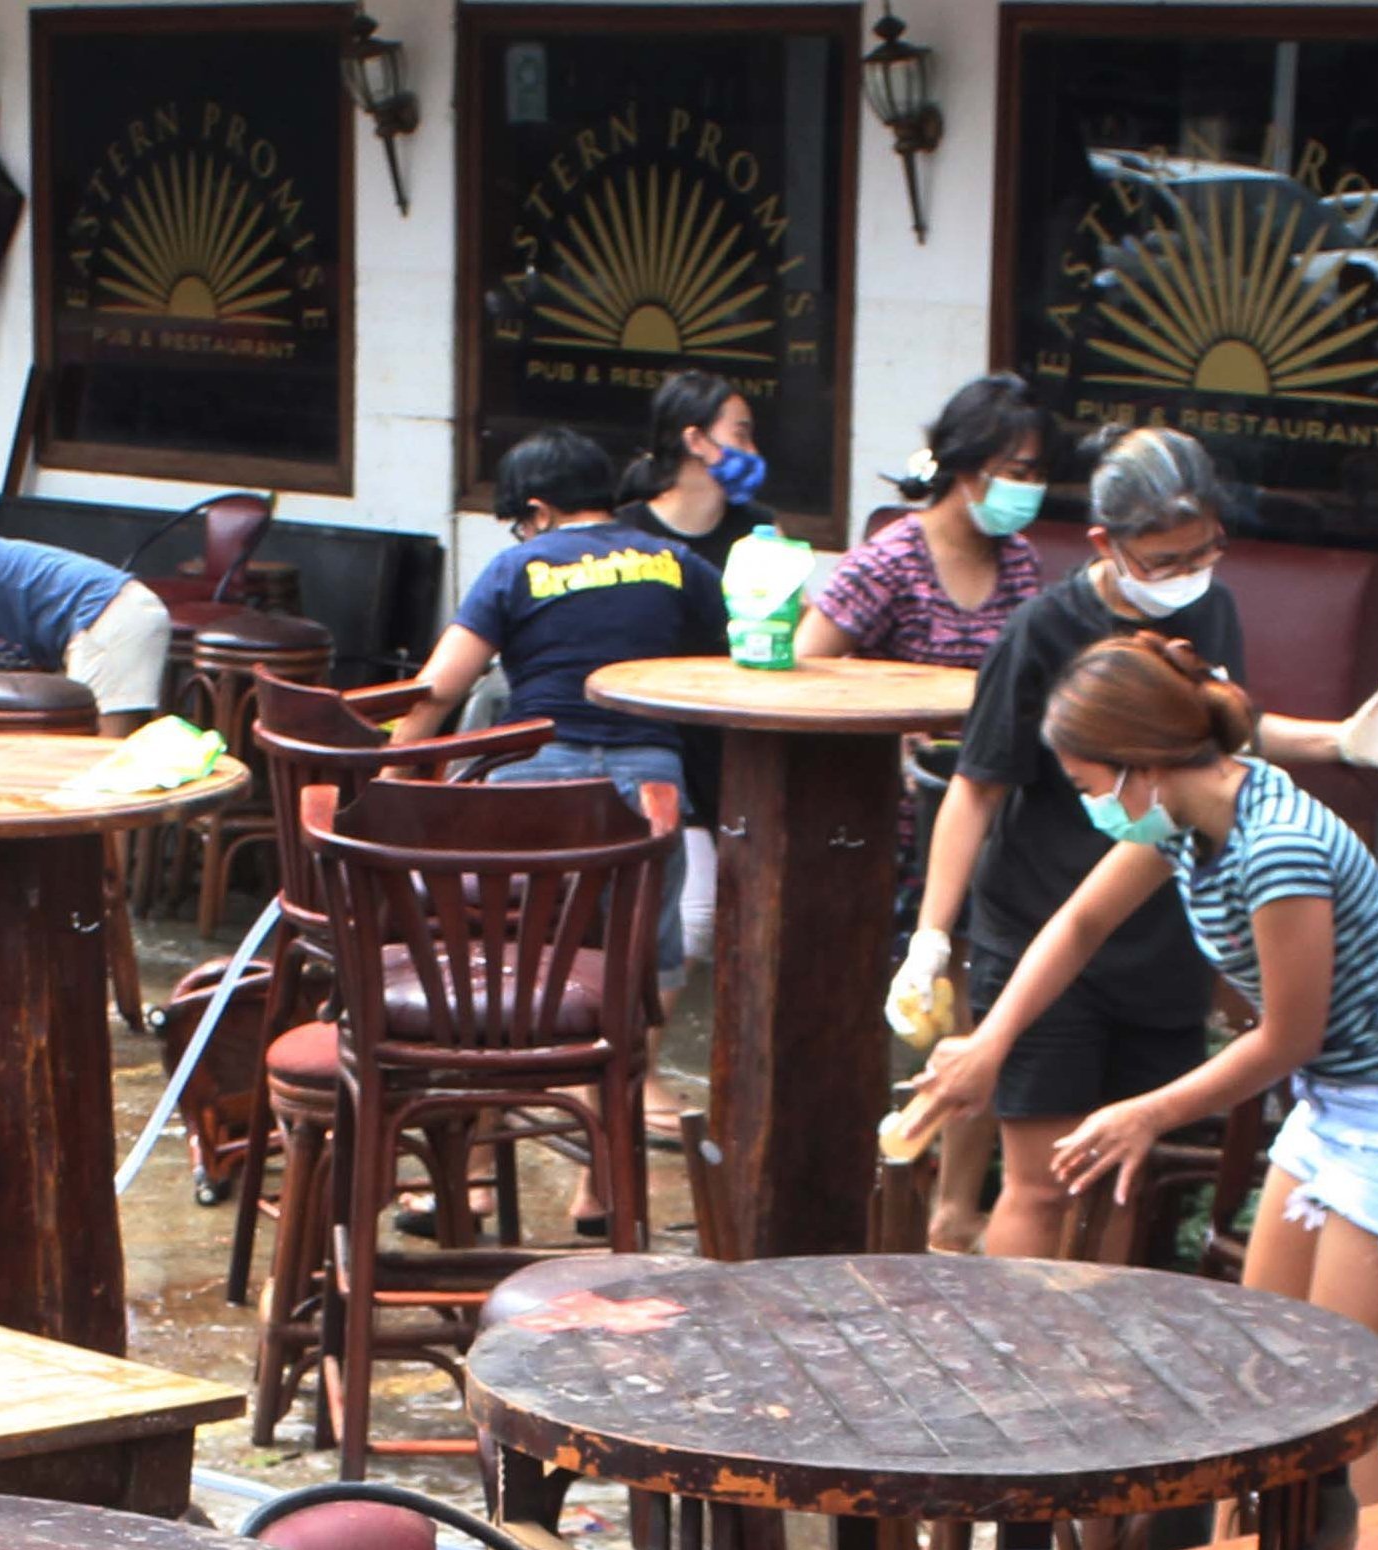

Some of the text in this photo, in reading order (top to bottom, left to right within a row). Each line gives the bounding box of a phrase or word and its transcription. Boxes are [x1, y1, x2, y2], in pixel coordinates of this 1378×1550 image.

[66, 100, 328, 330] EASTERN PROMISE
[495, 101, 818, 365] EASTERN PROMISE
[527, 360, 575, 383] PUB
[585, 365, 601, 384] &
